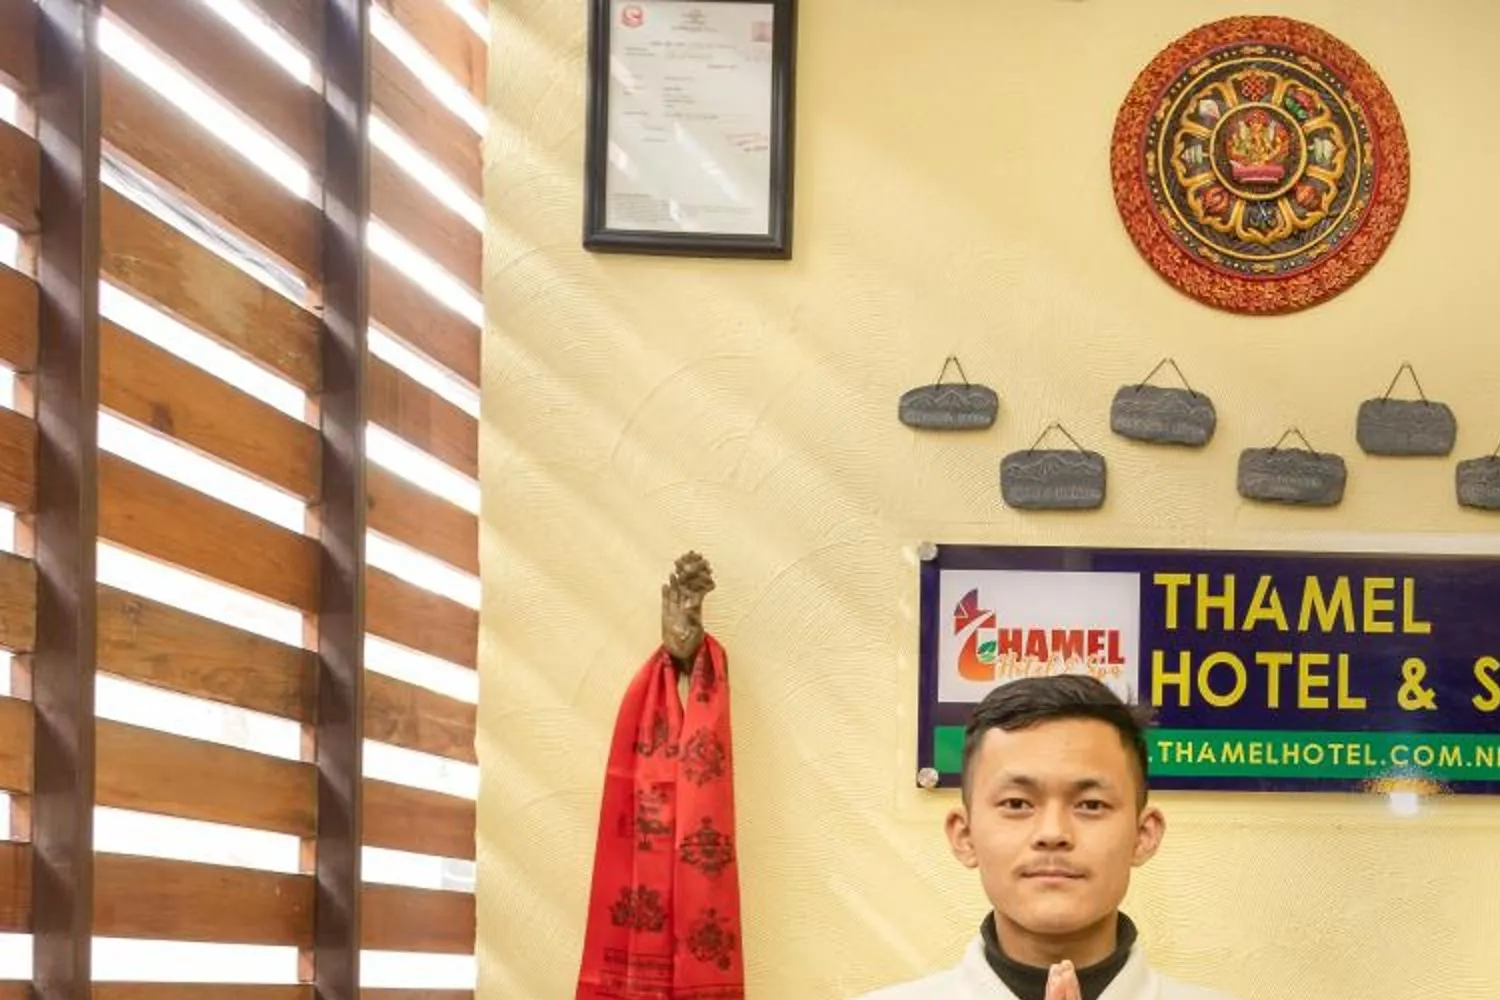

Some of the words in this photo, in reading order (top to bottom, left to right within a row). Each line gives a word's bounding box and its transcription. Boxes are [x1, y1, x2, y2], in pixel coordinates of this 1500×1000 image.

[1153, 573, 1432, 634] THAMEL
[1151, 650, 1367, 710] HOTEL
[1397, 656, 1438, 711] &
